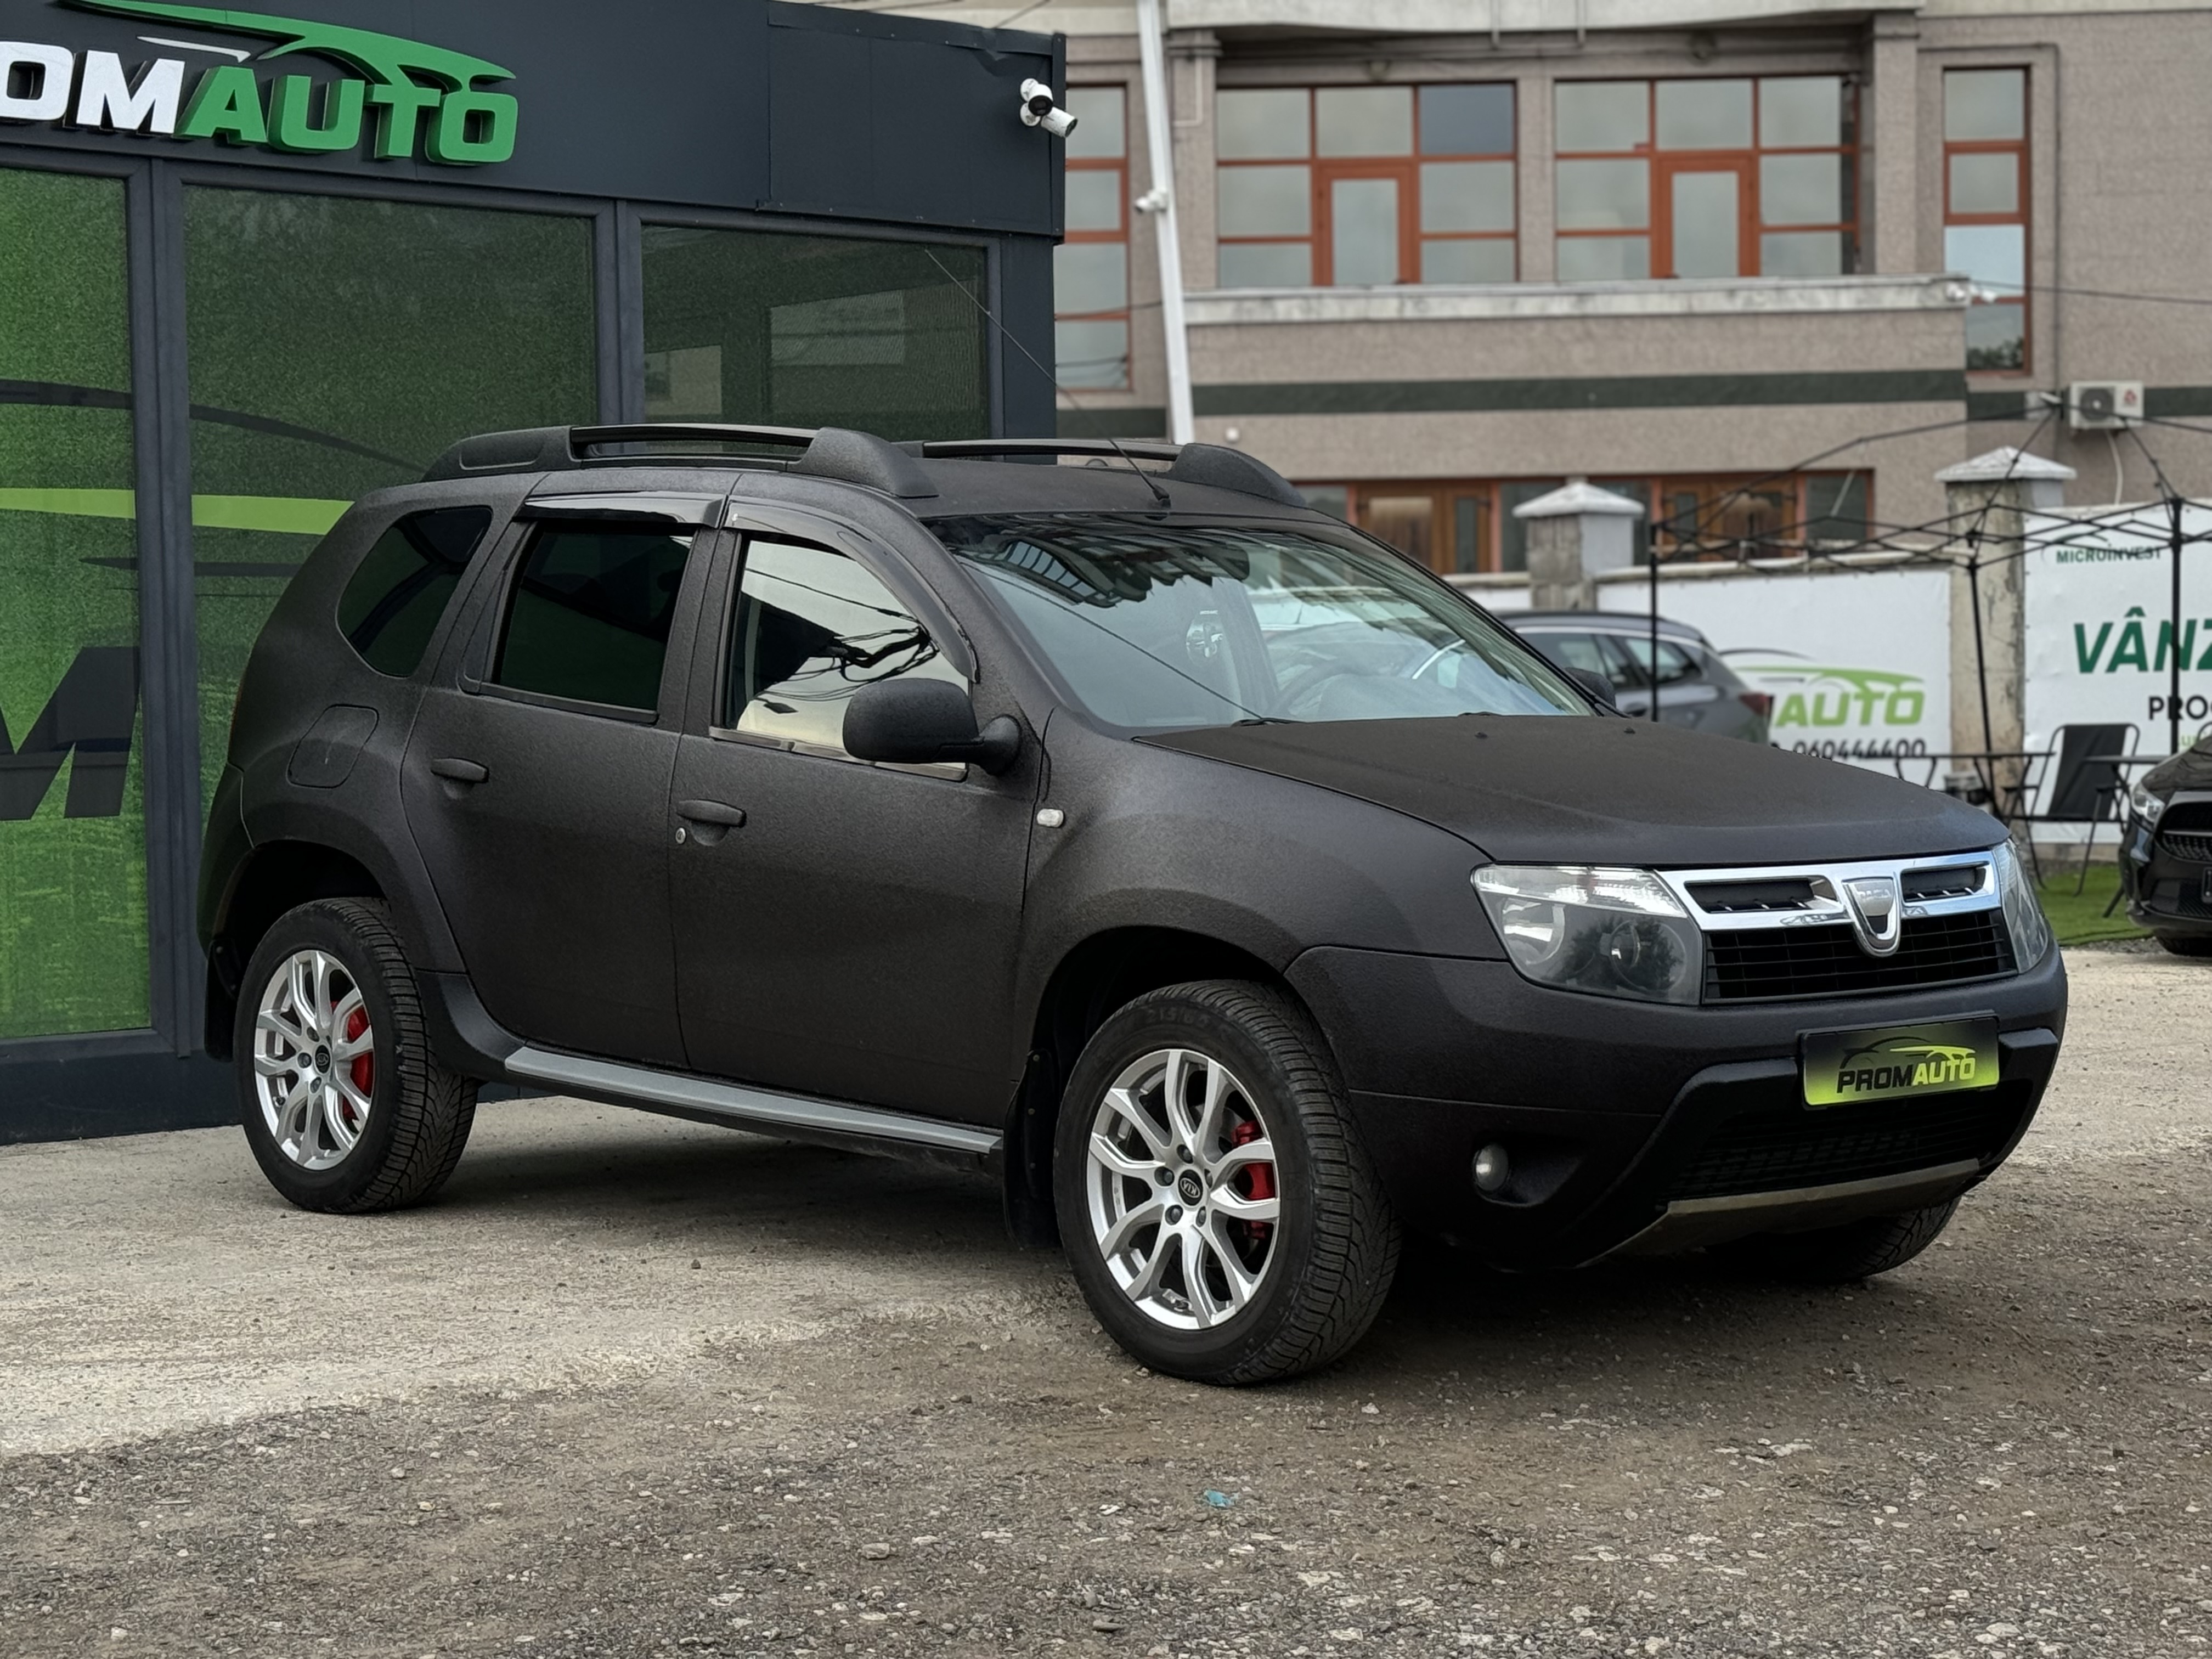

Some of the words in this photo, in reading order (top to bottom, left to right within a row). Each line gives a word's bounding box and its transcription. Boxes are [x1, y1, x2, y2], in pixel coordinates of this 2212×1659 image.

[2056, 546, 2160, 563] MICROINVEST
[2149, 695, 2212, 720] PRO
[1836, 1058, 1976, 1093] PROMAUTO
